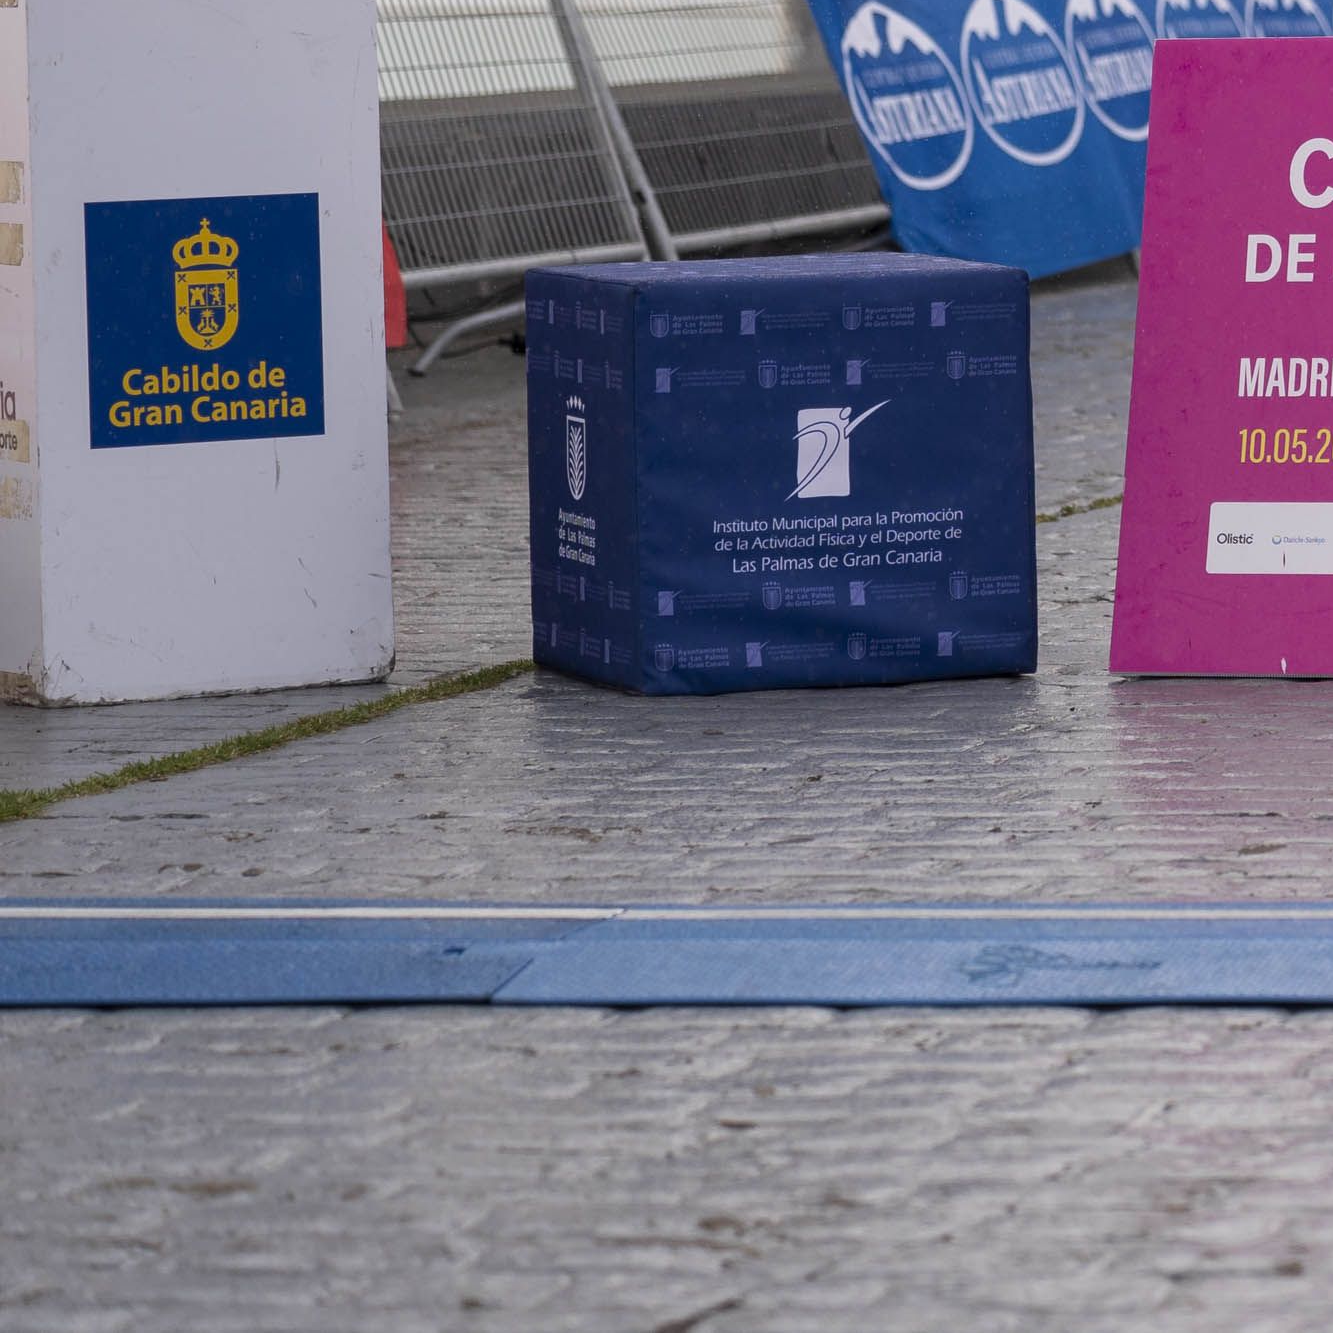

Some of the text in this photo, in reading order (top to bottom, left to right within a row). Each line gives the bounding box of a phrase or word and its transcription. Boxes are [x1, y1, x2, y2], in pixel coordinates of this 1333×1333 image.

[1245, 233, 1315, 284] DE
[122, 361, 285, 395] Cabildo de
[109, 391, 306, 428] Gran Canaria
[713, 507, 963, 533] Instituto Municipal para la Promoción
[714, 526, 962, 552] de la Actividad Física y el Deporte de
[1217, 533, 1253, 545] Olistic
[732, 548, 942, 573] Las Palmas de Gran Canaria
